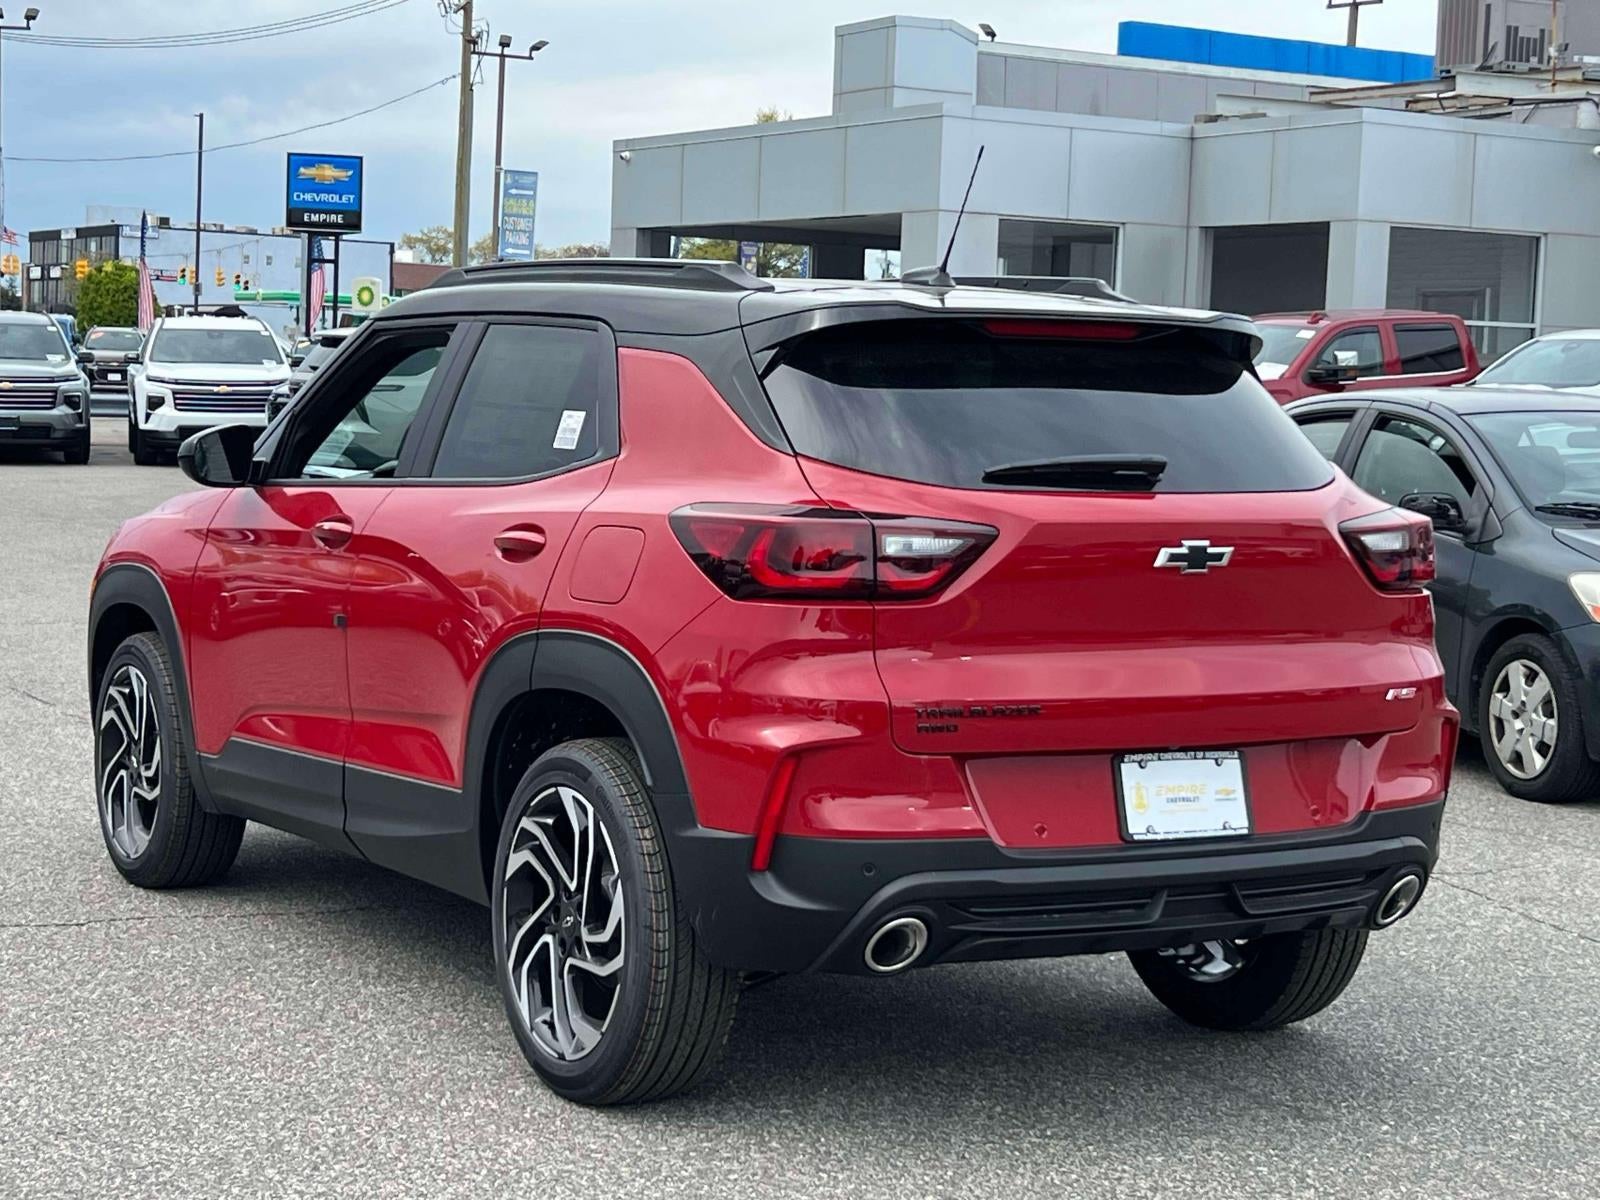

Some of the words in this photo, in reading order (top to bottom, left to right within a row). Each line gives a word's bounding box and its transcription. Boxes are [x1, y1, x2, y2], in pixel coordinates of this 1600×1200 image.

[293, 192, 355, 203] CHEVROLET
[303, 213, 344, 223] EMPIRE
[1156, 784, 1208, 796] EMPIRE
